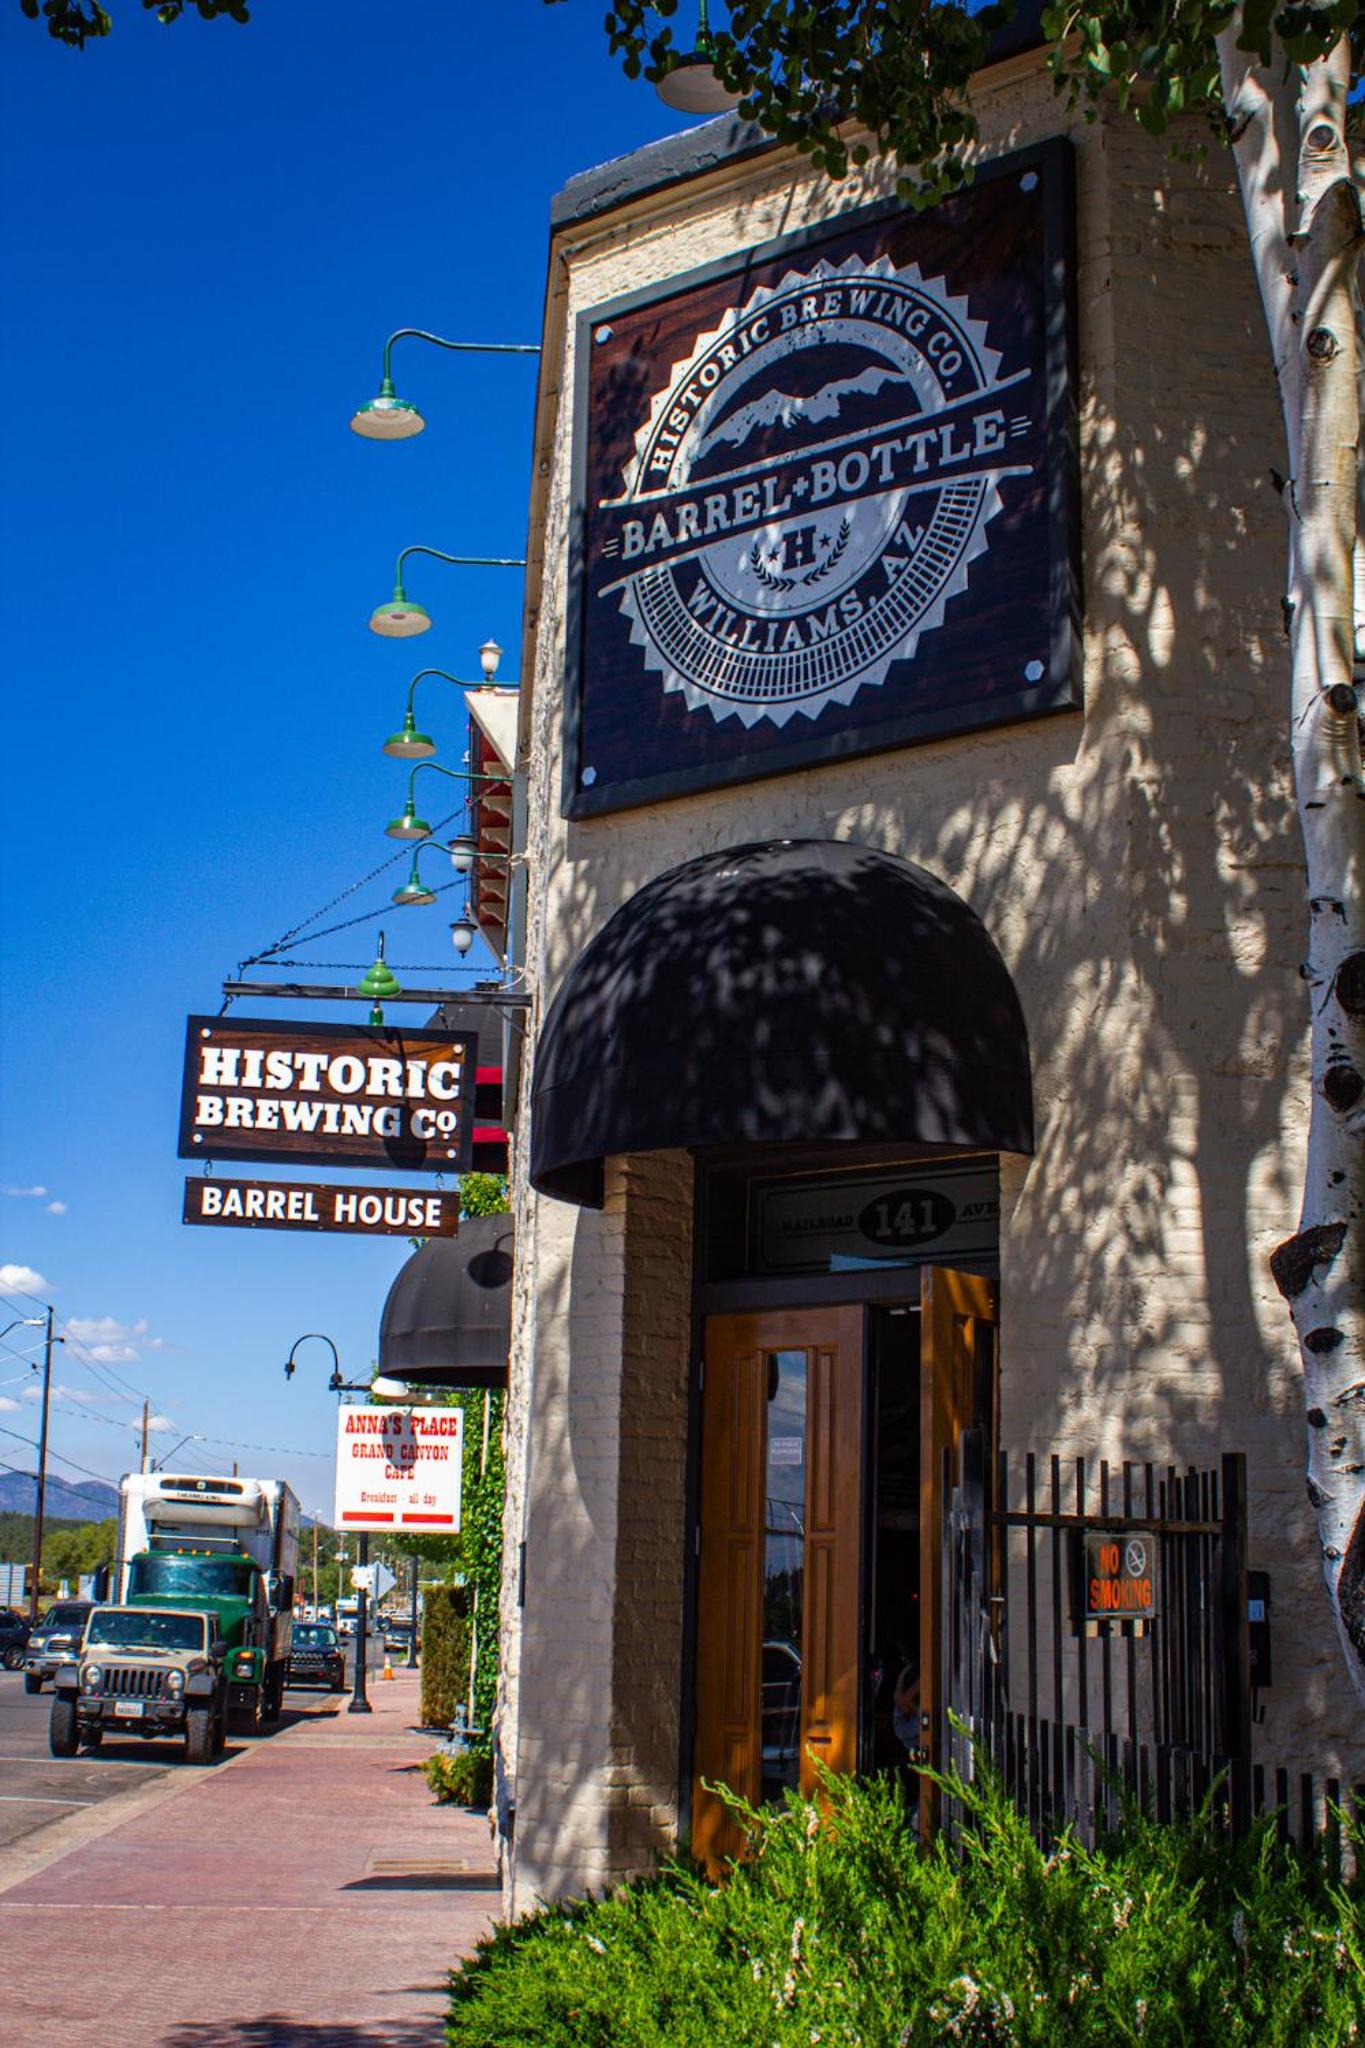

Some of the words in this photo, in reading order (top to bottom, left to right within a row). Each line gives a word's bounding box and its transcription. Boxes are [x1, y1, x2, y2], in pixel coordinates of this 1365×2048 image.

[650, 318, 770, 473] HISTORIC
[780, 289, 931, 338] BREWING
[881, 519, 924, 585] AZ
[199, 1047, 460, 1100] HISTORIC
[195, 1095, 401, 1137] BREWING
[201, 1187, 319, 1222] BARREL
[334, 1194, 441, 1227] HOUSE
[874, 1199, 937, 1237] 141
[345, 1414, 402, 1436] ANNA'S
[411, 1416, 457, 1437] PLACE
[352, 1443, 393, 1459] GRAND
[401, 1445, 449, 1461] CANYON
[1100, 1544, 1119, 1574] NO
[1090, 1578, 1151, 1609] SMOKING
